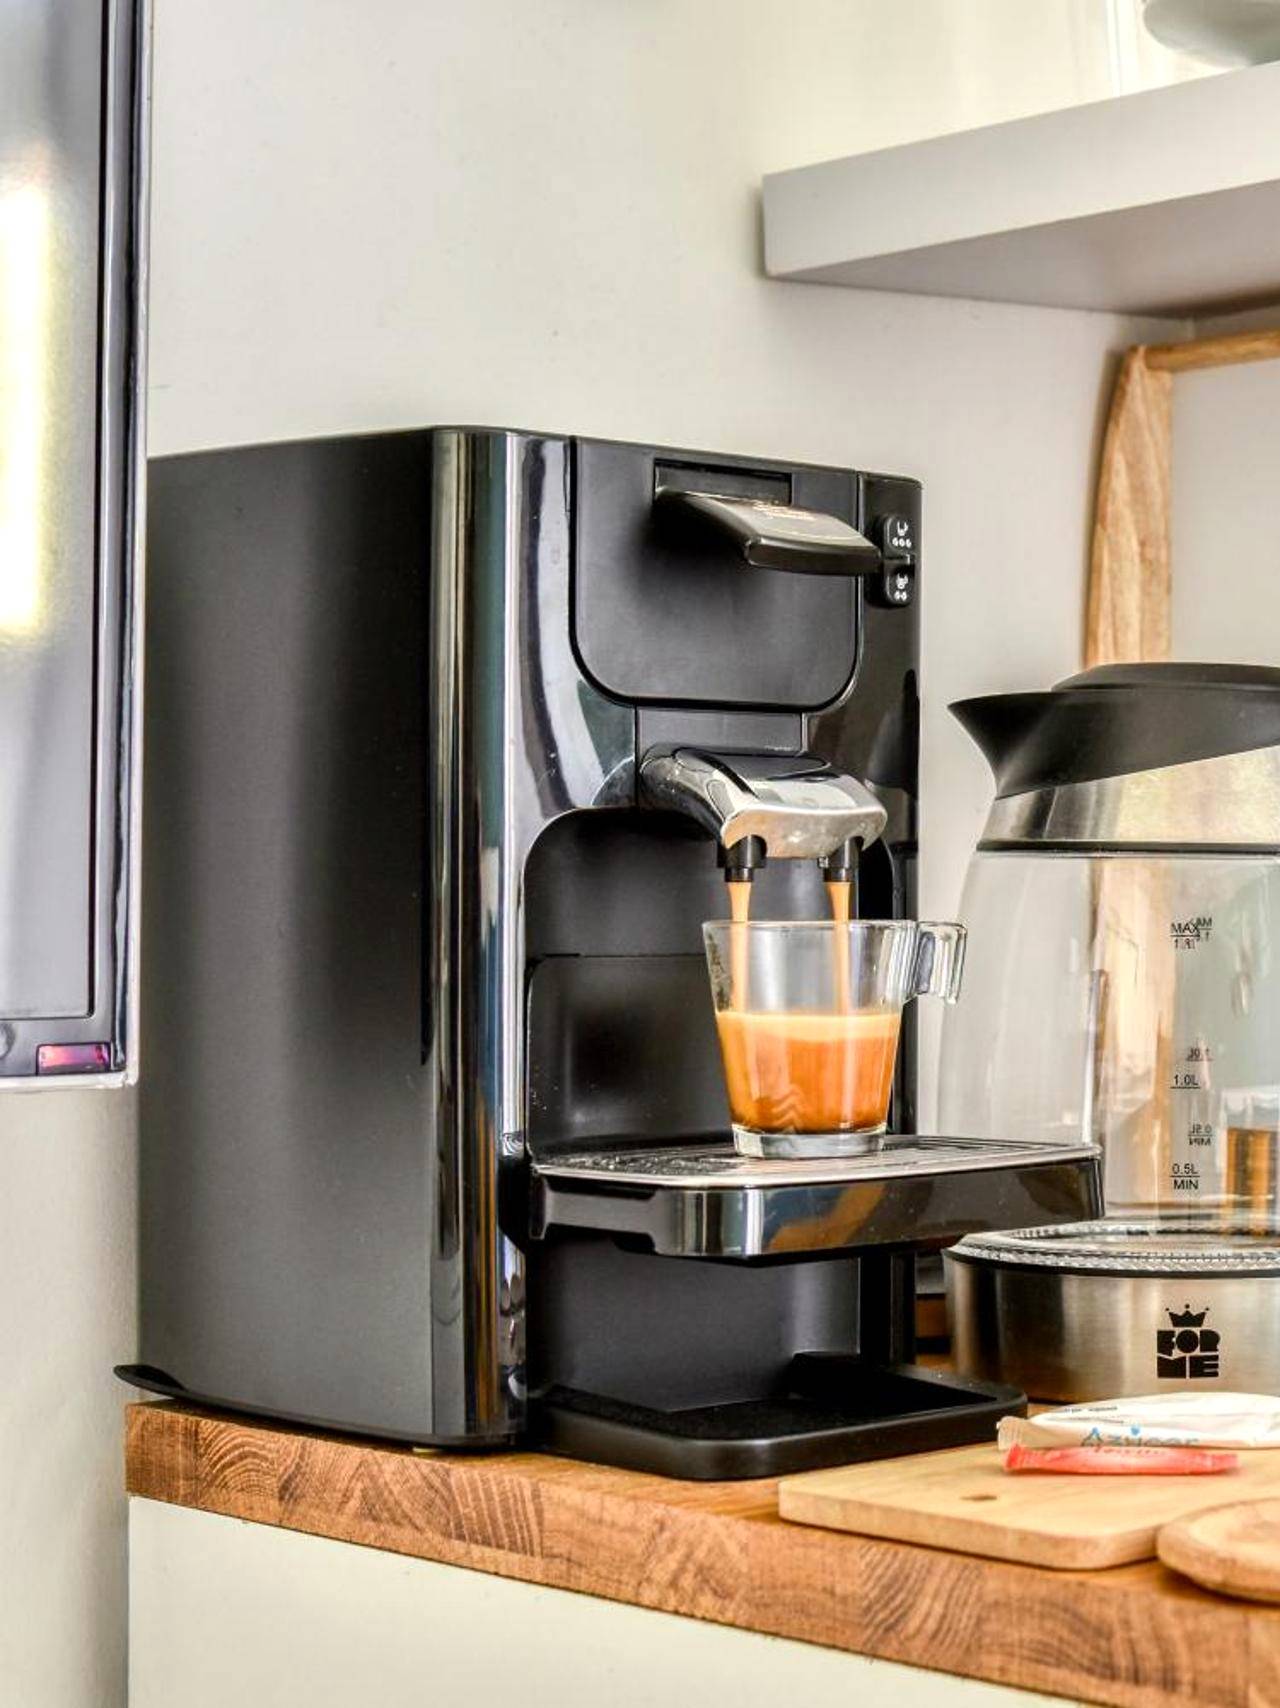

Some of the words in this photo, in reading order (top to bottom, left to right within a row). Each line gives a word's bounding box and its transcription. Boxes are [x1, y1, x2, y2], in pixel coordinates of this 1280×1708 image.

[1170, 921, 1201, 934] MAX
[1173, 1073, 1199, 1086] 1.0L
[1171, 1162, 1199, 1175] 0.5L
[1173, 1178, 1200, 1190] MIN
[1156, 1328, 1222, 1357] FOR
[1156, 1353, 1220, 1379] ME
